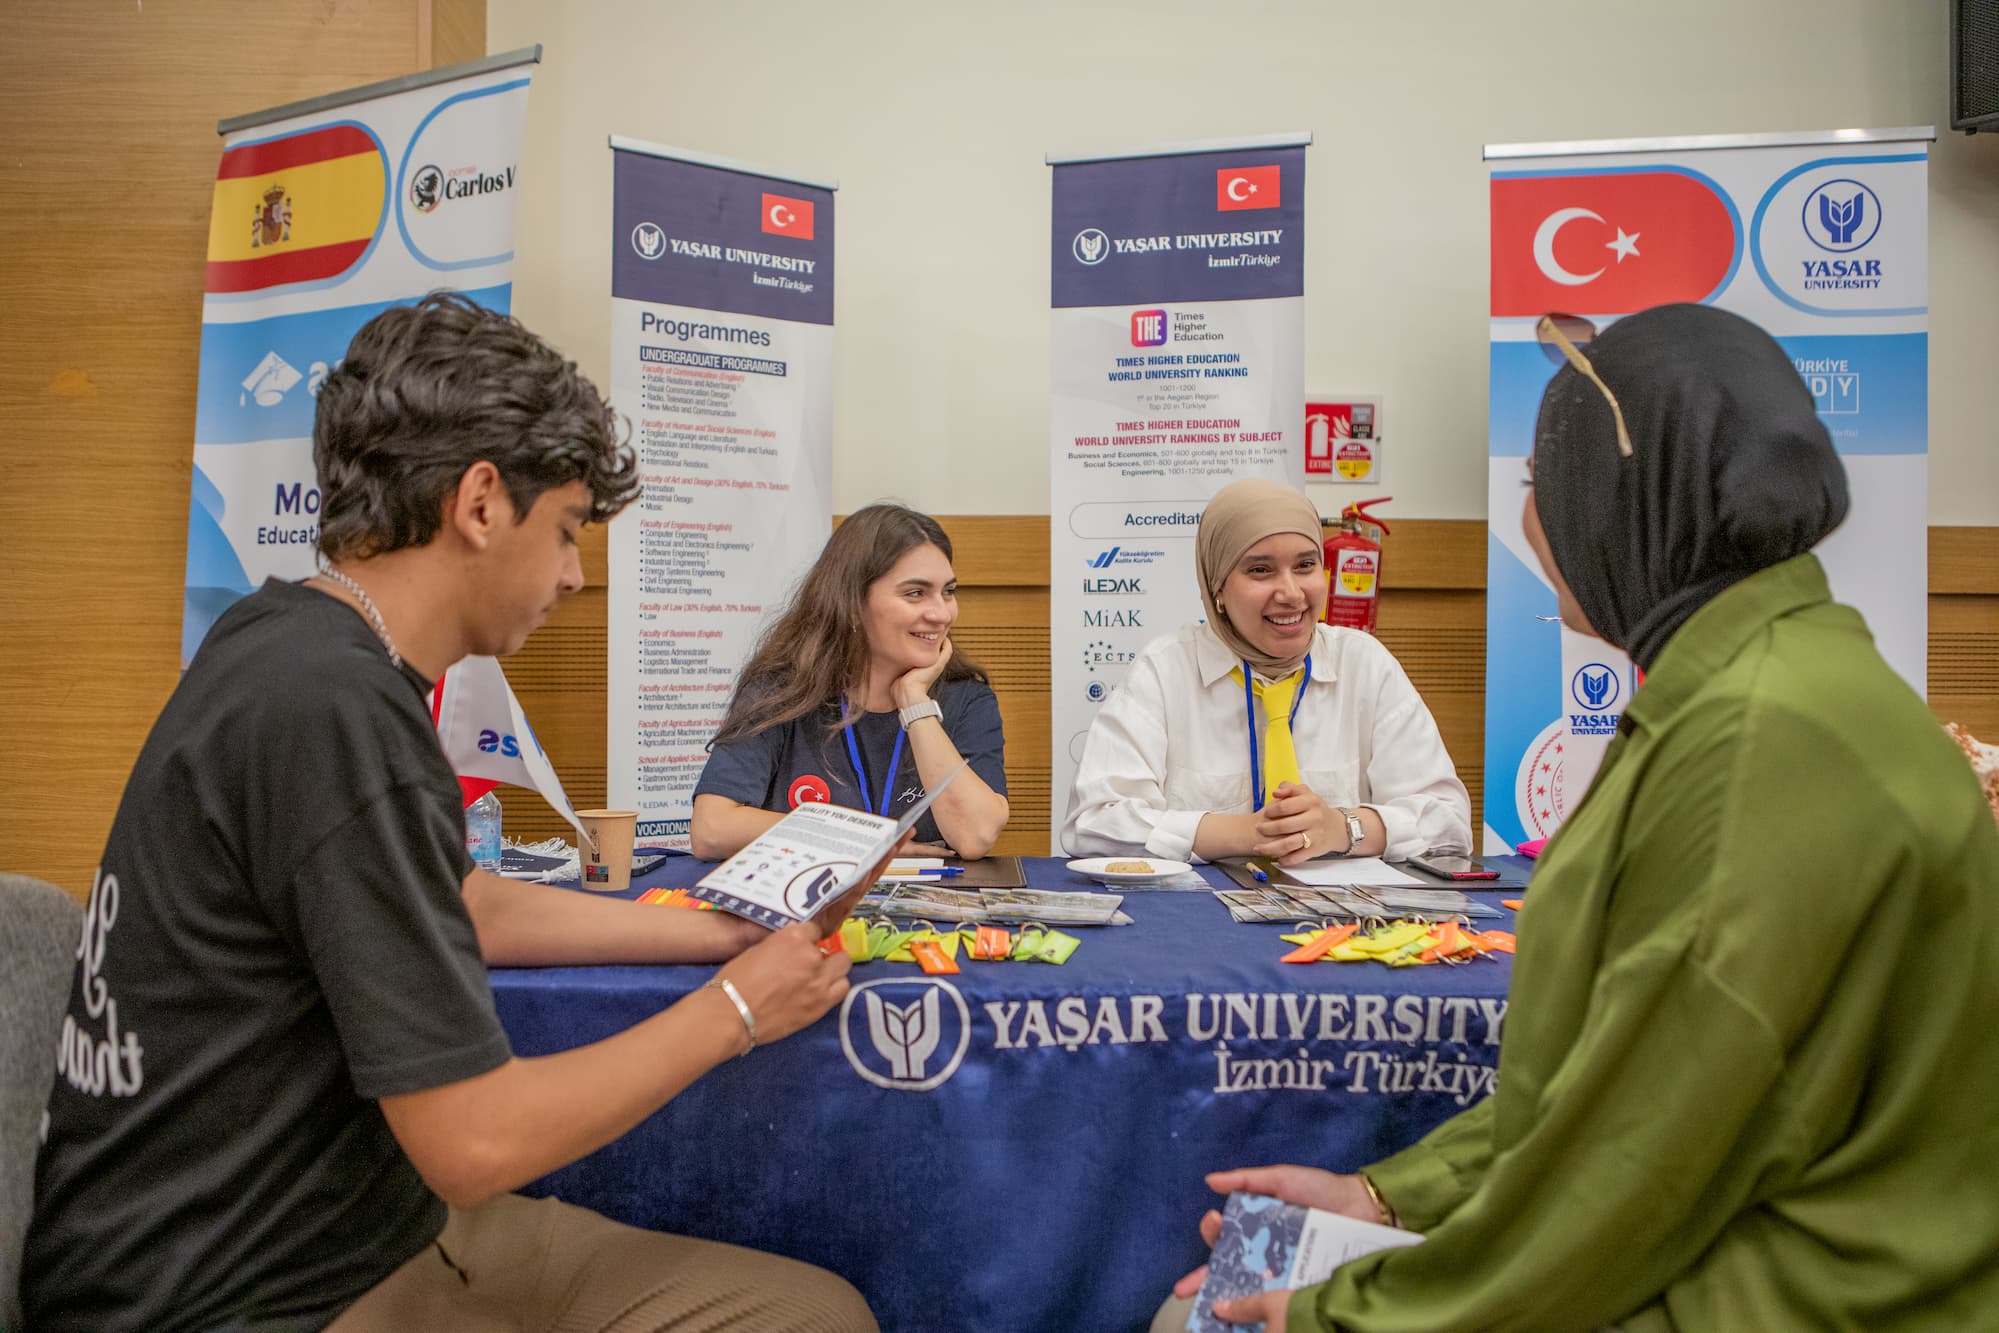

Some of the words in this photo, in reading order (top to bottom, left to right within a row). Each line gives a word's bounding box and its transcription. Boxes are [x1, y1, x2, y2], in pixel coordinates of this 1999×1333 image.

[445, 172, 504, 200] Carlos
[1114, 236, 1171, 254] YAŞAR
[1176, 229, 1283, 249] UNIVERSITY
[670, 238, 722, 260] YAŞAR
[726, 248, 815, 273] UNIVERSITY
[1802, 259, 1882, 280] YAŞAR
[1804, 278, 1881, 290] UNIVERSITY
[1174, 312, 1204, 320] Times
[641, 311, 770, 347] Programmes
[1136, 315, 1162, 342] THE
[1174, 322, 1207, 332] Higher
[1174, 331, 1224, 342] Education
[642, 347, 721, 368] UNDERGRADUATE
[722, 356, 784, 375] PROGRAMMES
[1115, 357, 1145, 368] TIMES
[1148, 355, 1183, 366] HIGHER
[1186, 353, 1240, 365] EDUCATION
[1108, 371, 1142, 382] WORLD
[1145, 369, 1201, 380] UNIVERSITY
[1204, 367, 1248, 378] RANKING
[1115, 421, 1145, 432] TIMES
[1148, 420, 1183, 431] HIGHER
[1186, 418, 1241, 430] EDUCATION
[1074, 436, 1109, 447] WORLD
[1112, 435, 1167, 446] UNIVERSITY
[1170, 433, 1221, 445] RANKINGS
[1223, 432, 1236, 443] BY
[1240, 431, 1283, 443] SUBJECT
[275, 482, 320, 515] Mo
[644, 638, 676, 647] Economics
[1094, 652, 1136, 662] ECTS
[983, 995, 1169, 1052] YAŞAR
[1185, 992, 1508, 1048] UNIVERSITY
[1214, 1041, 1334, 1093] İzmir
